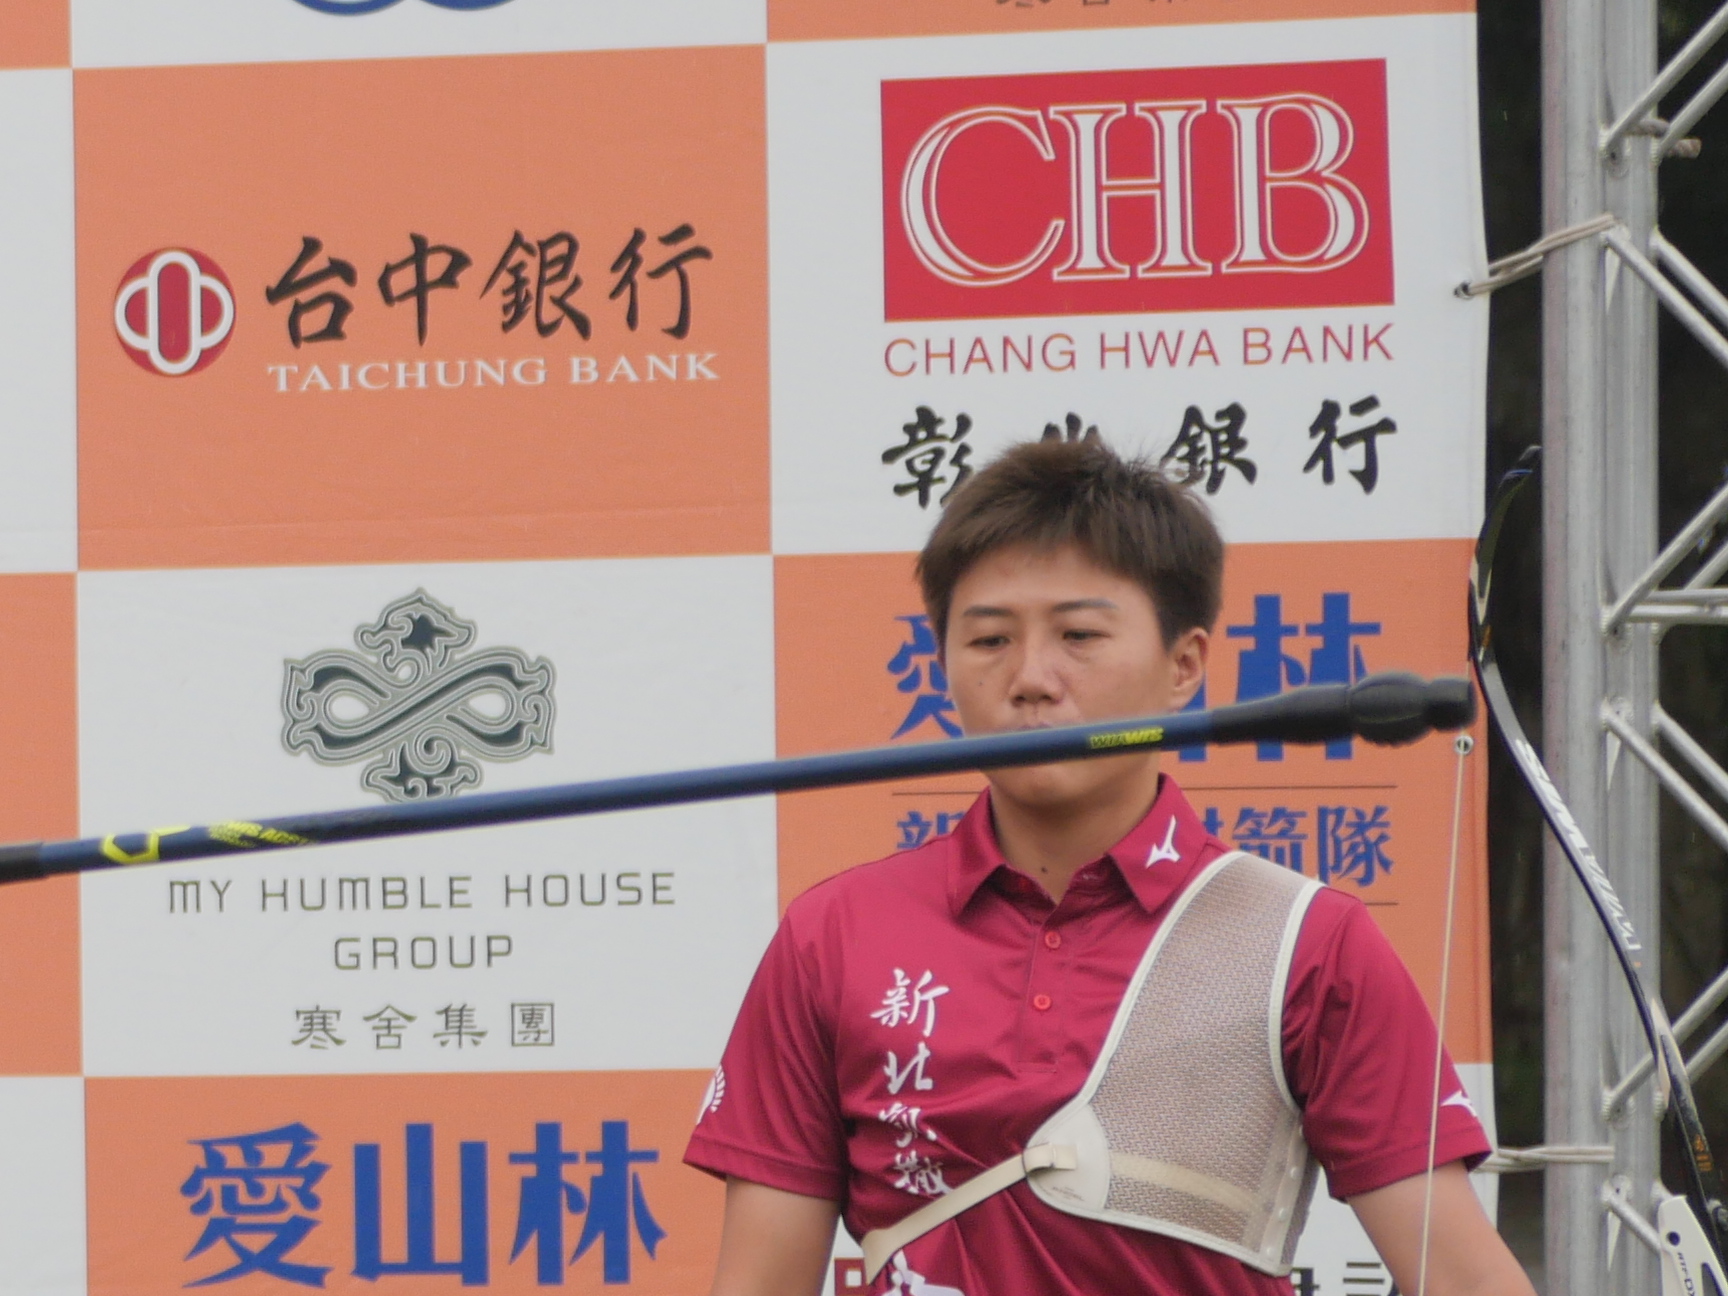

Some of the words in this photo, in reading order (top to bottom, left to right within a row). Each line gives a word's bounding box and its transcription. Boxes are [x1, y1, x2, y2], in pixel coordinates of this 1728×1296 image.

[900, 92, 1369, 286] CHB
[265, 223, 713, 348] 台中銀行
[267, 357, 548, 393] TAICHUNG
[570, 352, 720, 385] BANK
[884, 333, 1077, 377] CHANG
[1100, 329, 1220, 369] HWA
[1242, 322, 1395, 365] BANK
[169, 878, 232, 914] MY
[262, 875, 472, 912] HUMBLE
[504, 871, 676, 908] HOUSE
[334, 935, 513, 971] GROUP
[292, 1002, 554, 1050] 寒舍集團
[181, 1120, 668, 1289] 愛山林
